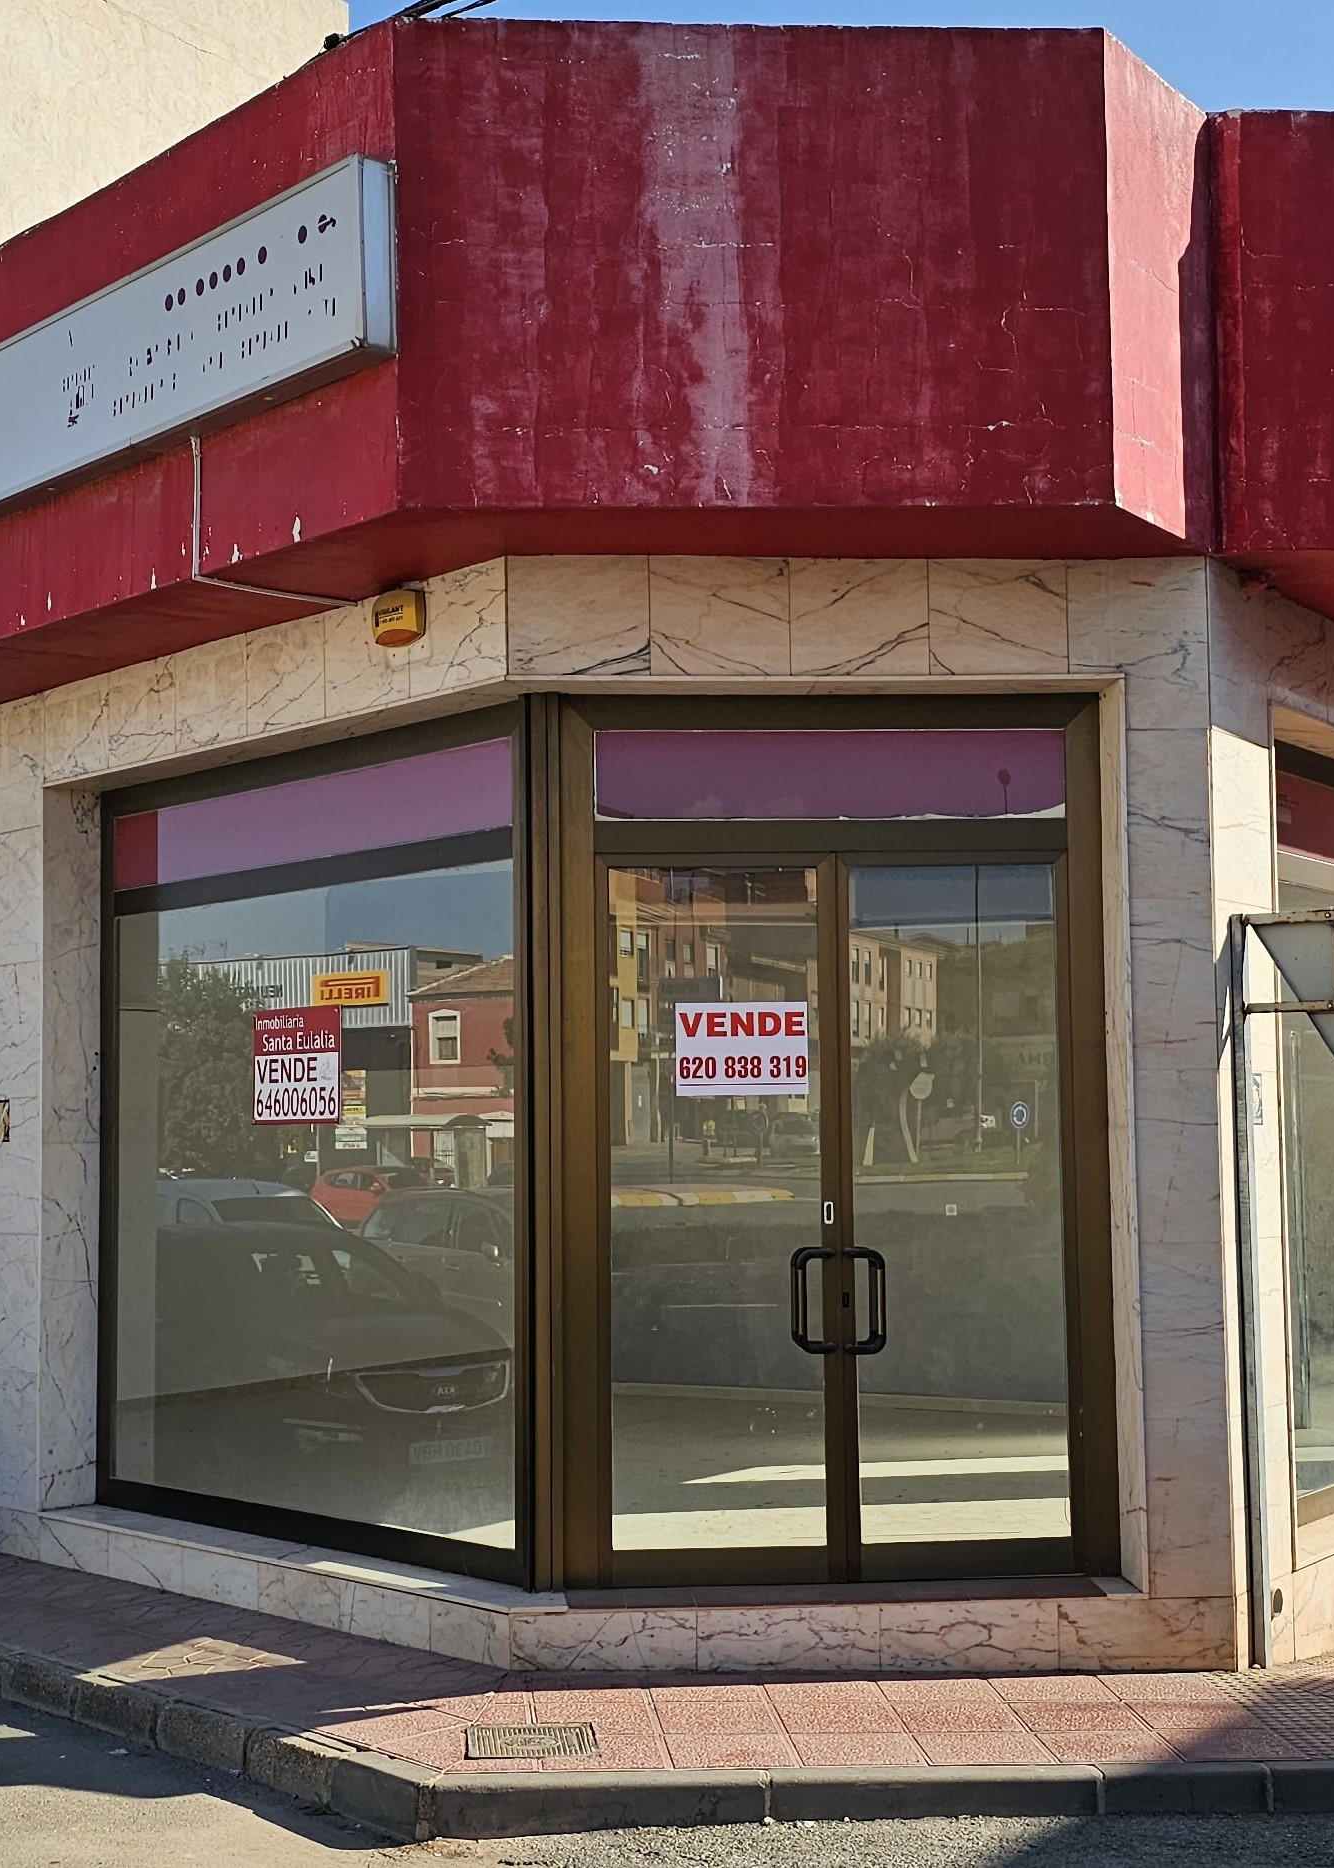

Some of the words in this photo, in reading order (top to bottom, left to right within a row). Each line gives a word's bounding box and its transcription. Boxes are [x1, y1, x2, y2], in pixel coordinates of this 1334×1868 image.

[255, 1014, 304, 1031] Inmobiliaria
[678, 1011, 806, 1037] VENDE
[262, 1033, 293, 1052] Santa
[296, 1030, 336, 1050] Eulalia
[256, 1056, 318, 1085] VENDE
[679, 1056, 717, 1079] 620
[724, 1056, 762, 1079] 838
[769, 1055, 807, 1078] 319
[256, 1086, 336, 1117] 646006056
